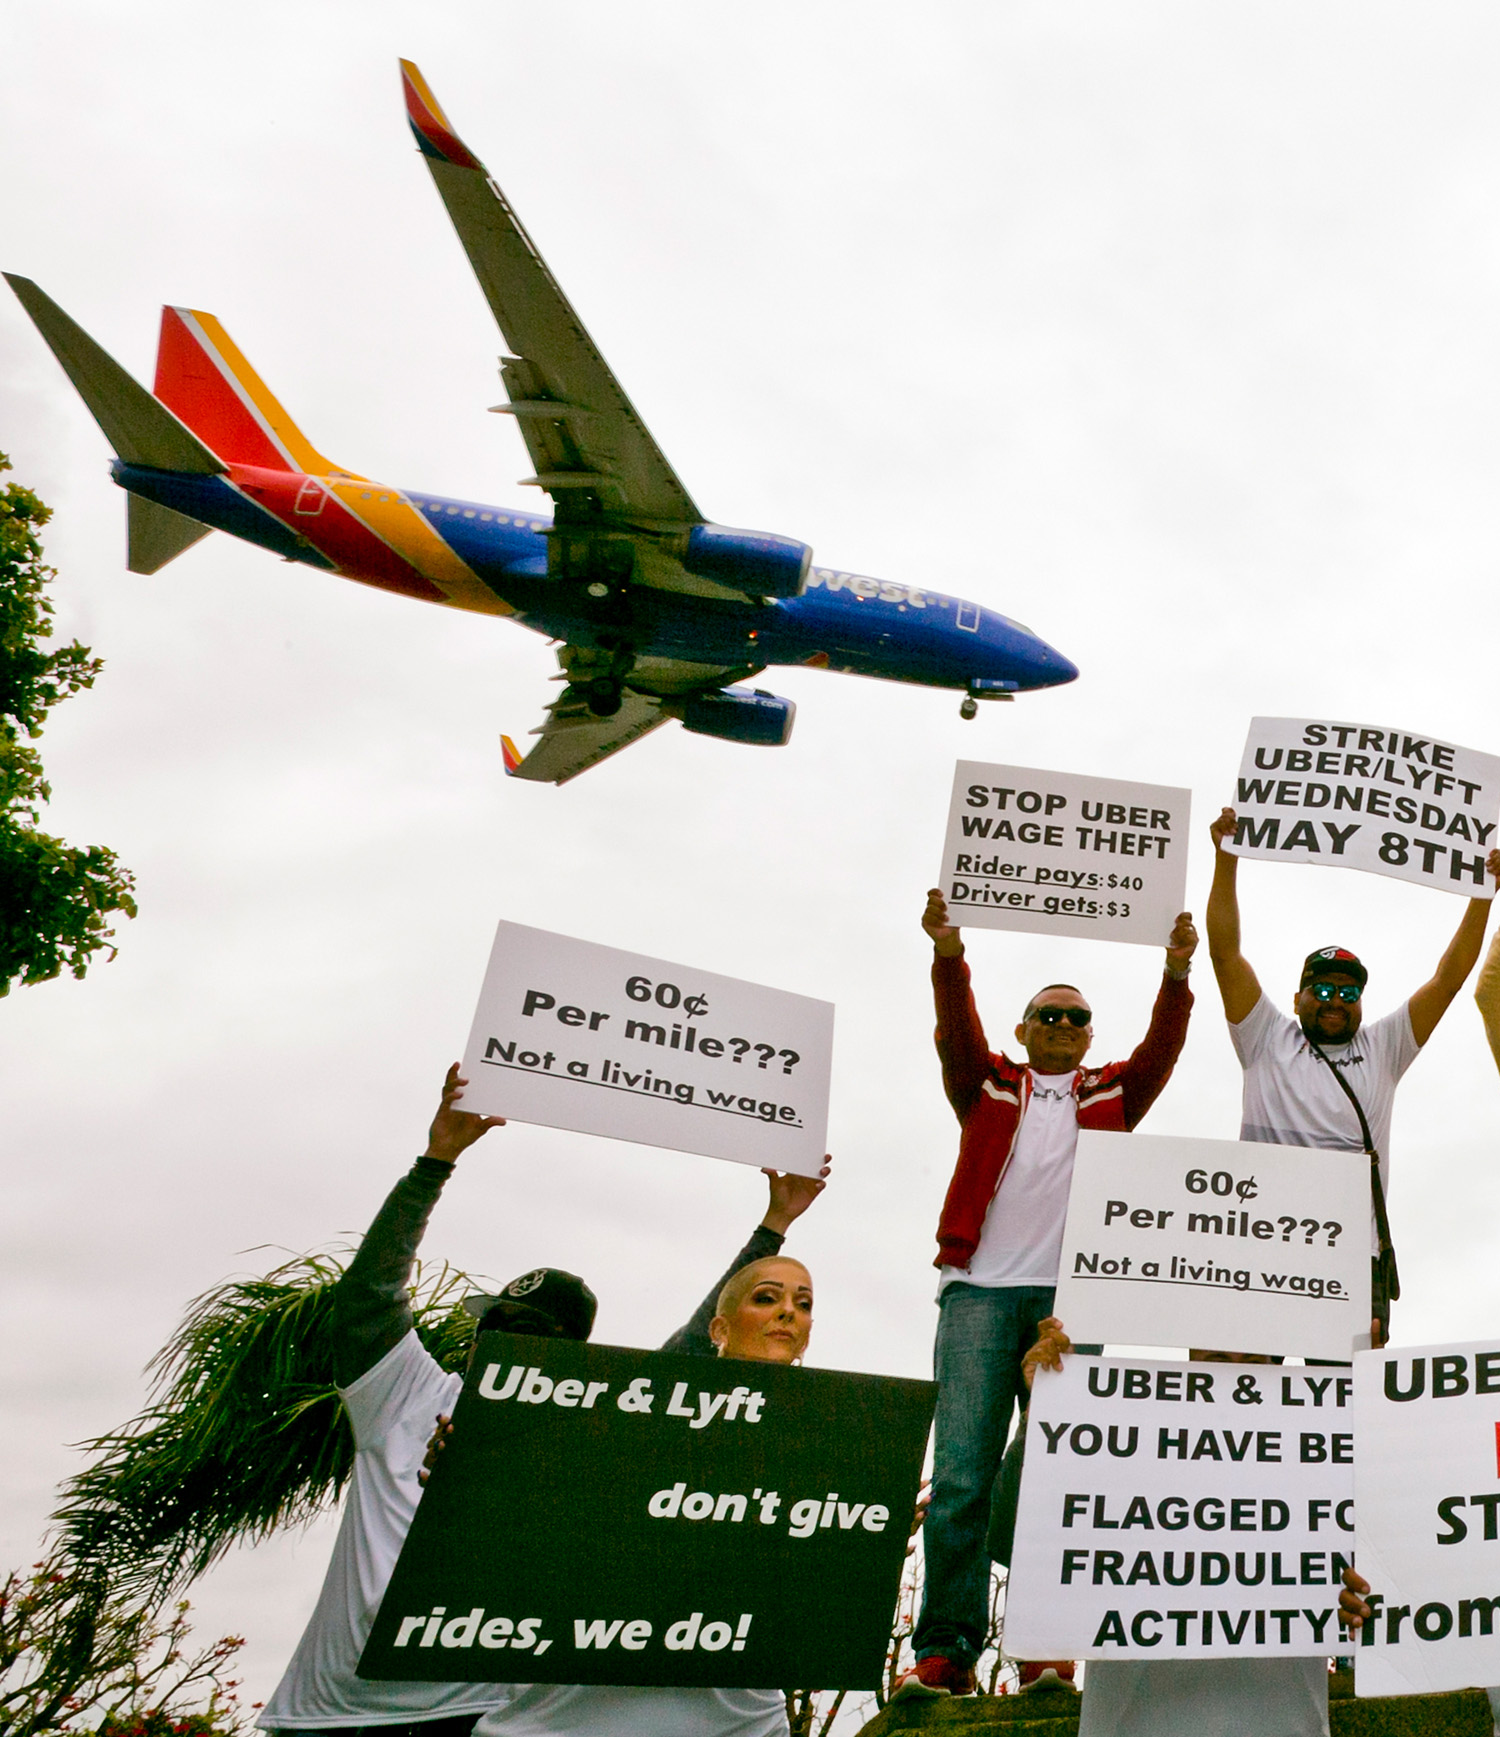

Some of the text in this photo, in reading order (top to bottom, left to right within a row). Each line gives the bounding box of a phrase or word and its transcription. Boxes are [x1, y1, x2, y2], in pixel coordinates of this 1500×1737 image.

[1302, 724, 1455, 772] STRIKE
[1254, 747, 1482, 806] UBER/LYFT
[966, 785, 1171, 831] STOP UBER
[1237, 777, 1497, 846] WEDNESDAY
[961, 816, 1171, 859] WAGE THEFT
[1232, 816, 1485, 885] MAY 8TH
[955, 854, 1027, 877] Rider
[950, 882, 1035, 907] Driver
[625, 976, 709, 1019] 60¢
[521, 989, 801, 1075] Per mile???
[484, 1037, 803, 1123] Not a living wage.
[1185, 1169, 1259, 1204] 60¢
[1104, 1200, 1343, 1247] Per mile???
[1074, 1252, 1349, 1298] Not a living wage.
[478, 1363, 766, 1429] Uber & Lyft
[1087, 1366, 1353, 1408] UBER & LYF
[1038, 1421, 1354, 1464] YOU HAVE BE
[788, 1493, 890, 1538] give
[1061, 1493, 1355, 1532] FLAGGED FO
[1060, 1549, 1355, 1586] FRAUDULEN
[393, 1606, 753, 1656] rides, we do!
[1092, 1608, 1348, 1647] ACTIVITY!
